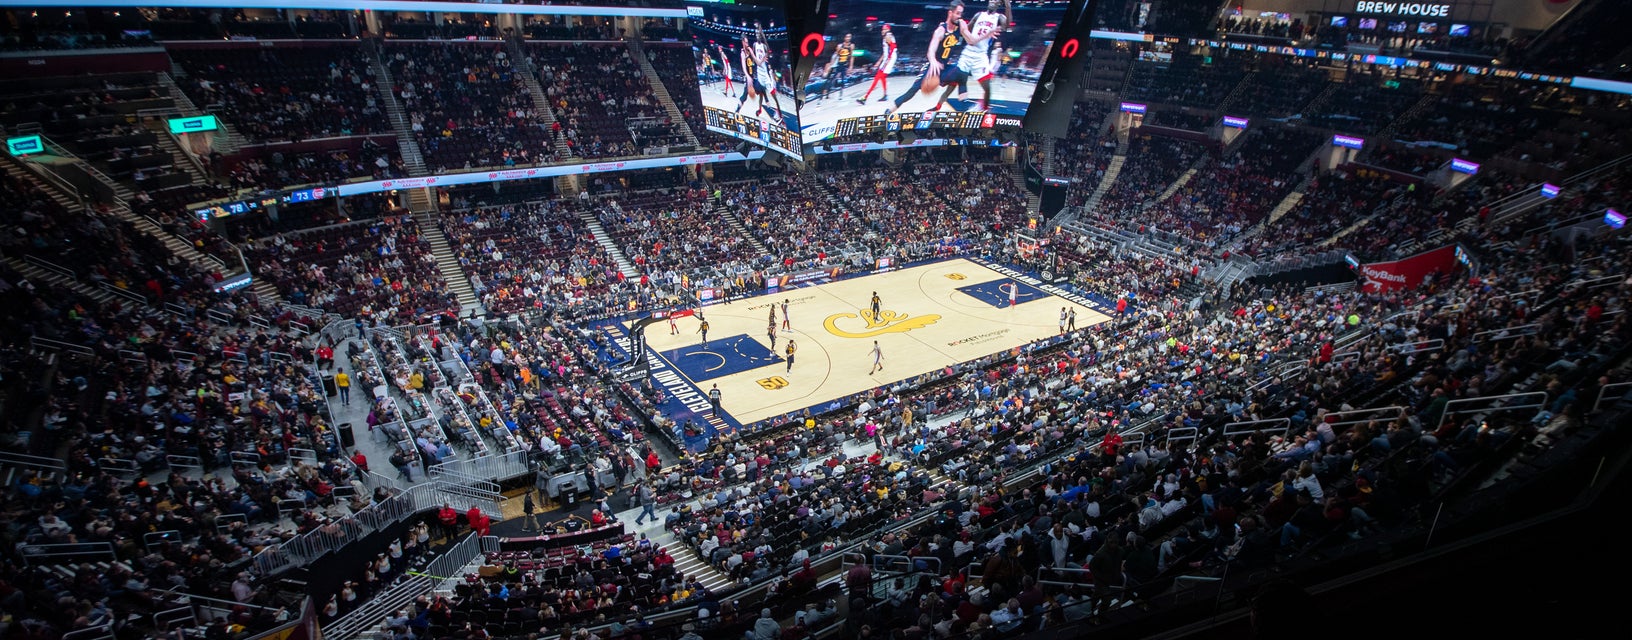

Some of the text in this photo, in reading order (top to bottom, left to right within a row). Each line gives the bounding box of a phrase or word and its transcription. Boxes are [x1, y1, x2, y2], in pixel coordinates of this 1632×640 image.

[1356, 1, 1450, 16] BREW HOUSE
[808, 126, 836, 136] CLIFFS
[889, 122, 898, 130] 78
[297, 192, 309, 200] 73
[230, 204, 244, 214] 78
[1362, 266, 1406, 282] KeyBank
[986, 263, 1100, 308] CLEVELAND CAVALIERS
[948, 336, 978, 346] ROCKET
[756, 376, 789, 390] 50
[652, 370, 713, 413] CLEVELAND
